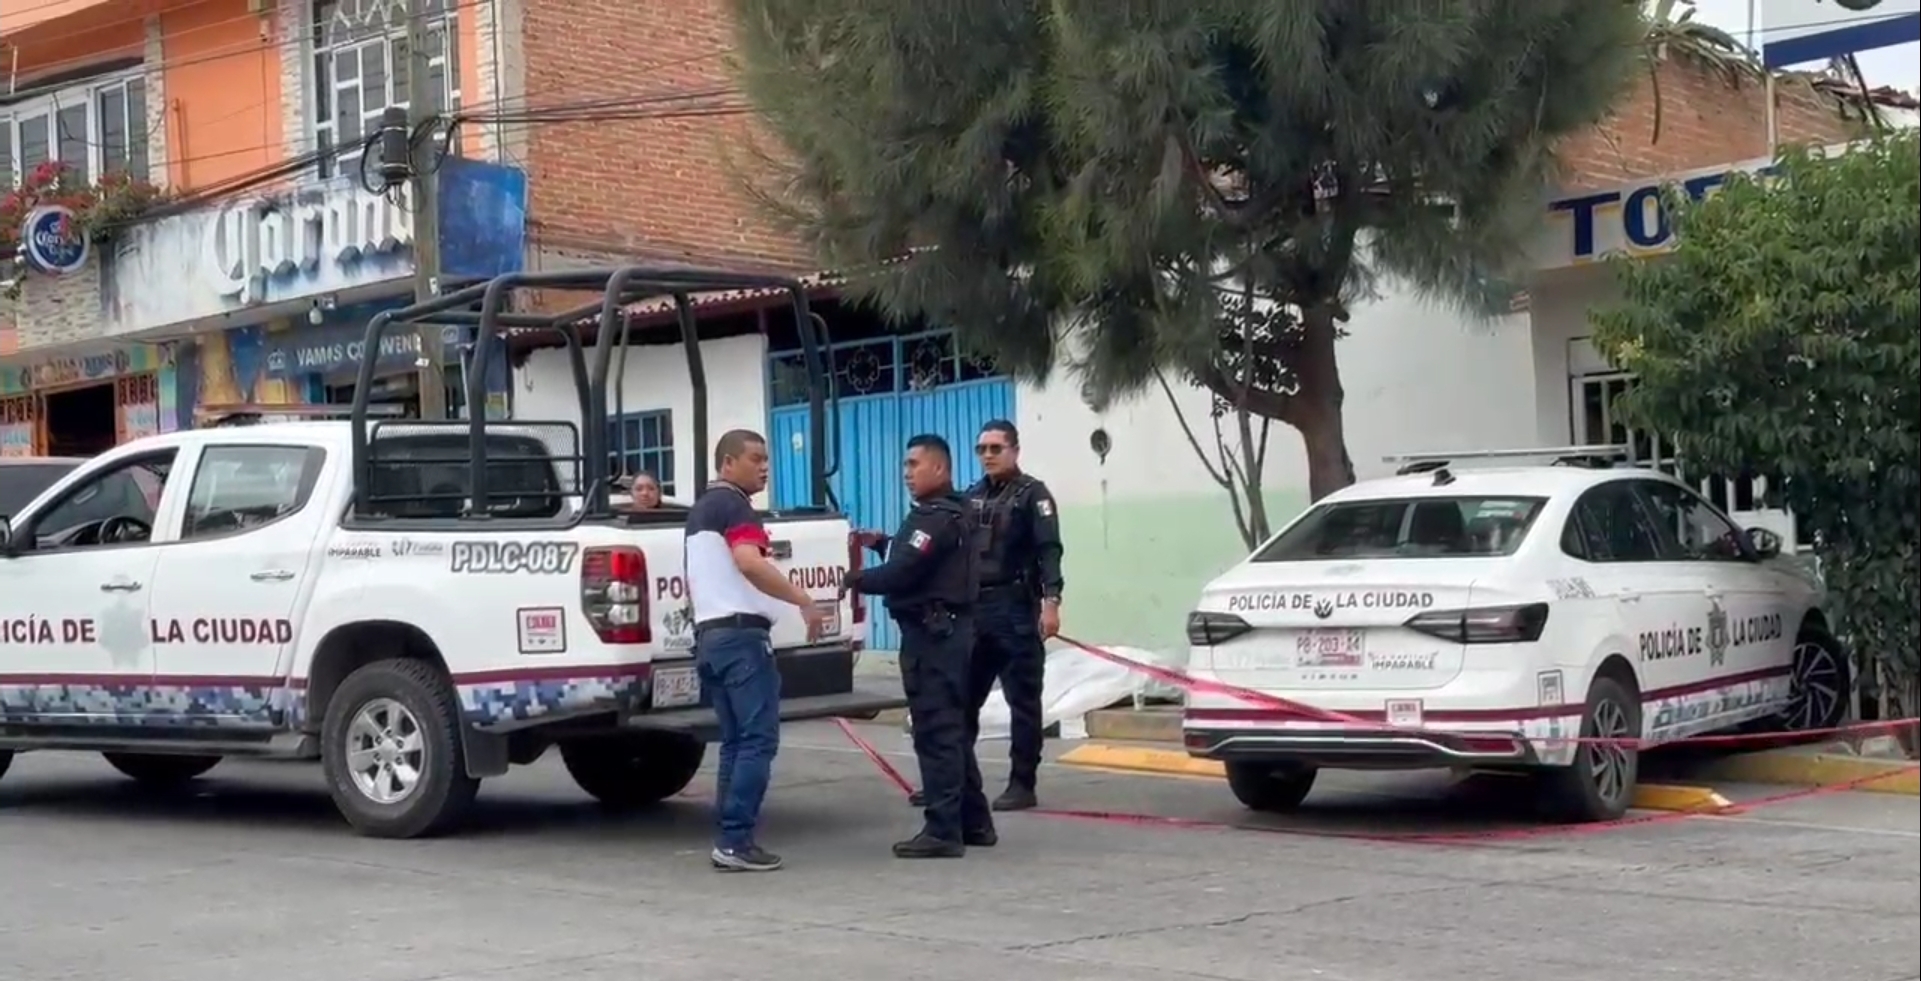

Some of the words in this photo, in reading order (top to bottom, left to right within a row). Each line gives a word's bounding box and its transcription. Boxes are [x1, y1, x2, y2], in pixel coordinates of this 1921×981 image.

[451, 541, 578, 574] PDLC-087
[1229, 591, 1287, 611] POLICÍA
[1291, 594, 1313, 609] DE
[1336, 593, 1358, 609] LA
[1363, 592, 1434, 608] CIUDAD
[0, 614, 54, 644] ICÍA
[62, 619, 96, 644] DE
[151, 618, 185, 644] LA
[193, 618, 293, 644] CIUDAD
[1639, 622, 1685, 661] POLICÍA
[1688, 627, 1702, 655] DE
[1733, 617, 1746, 646] LA
[1748, 613, 1782, 644] CIUDAD
[1372, 660, 1435, 670] IMPARABLE
